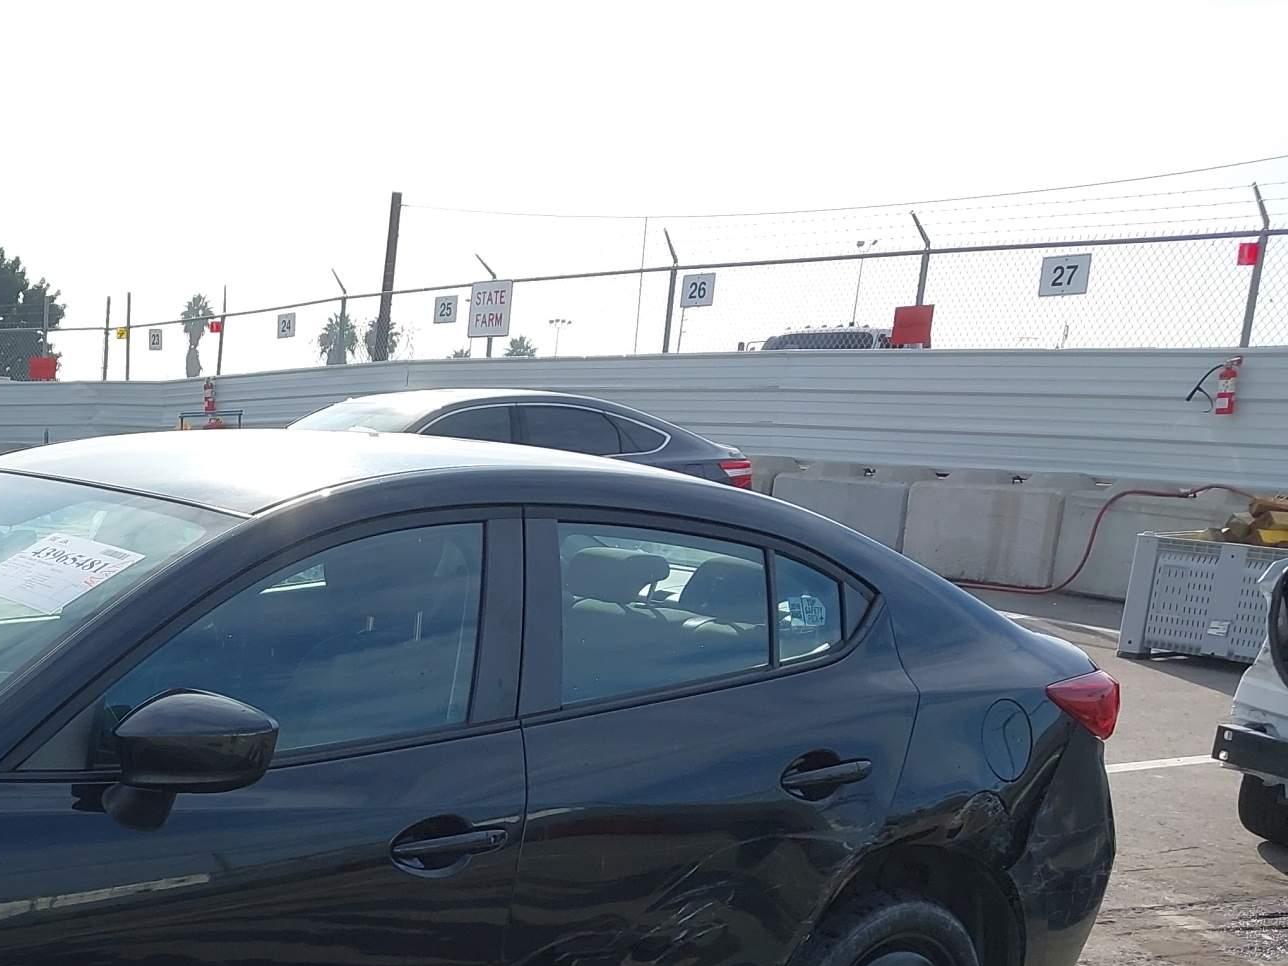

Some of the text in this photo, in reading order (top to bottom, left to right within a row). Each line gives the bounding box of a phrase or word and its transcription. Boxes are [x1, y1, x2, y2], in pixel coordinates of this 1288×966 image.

[1051, 264, 1079, 287] 27
[475, 290, 507, 306] STATE
[688, 281, 707, 299] 26
[439, 302, 453, 317] 25
[281, 319, 291, 333] 24
[474, 312, 503, 329] FARM
[151, 333, 160, 346] 23
[31, 546, 110, 574] 43965481
